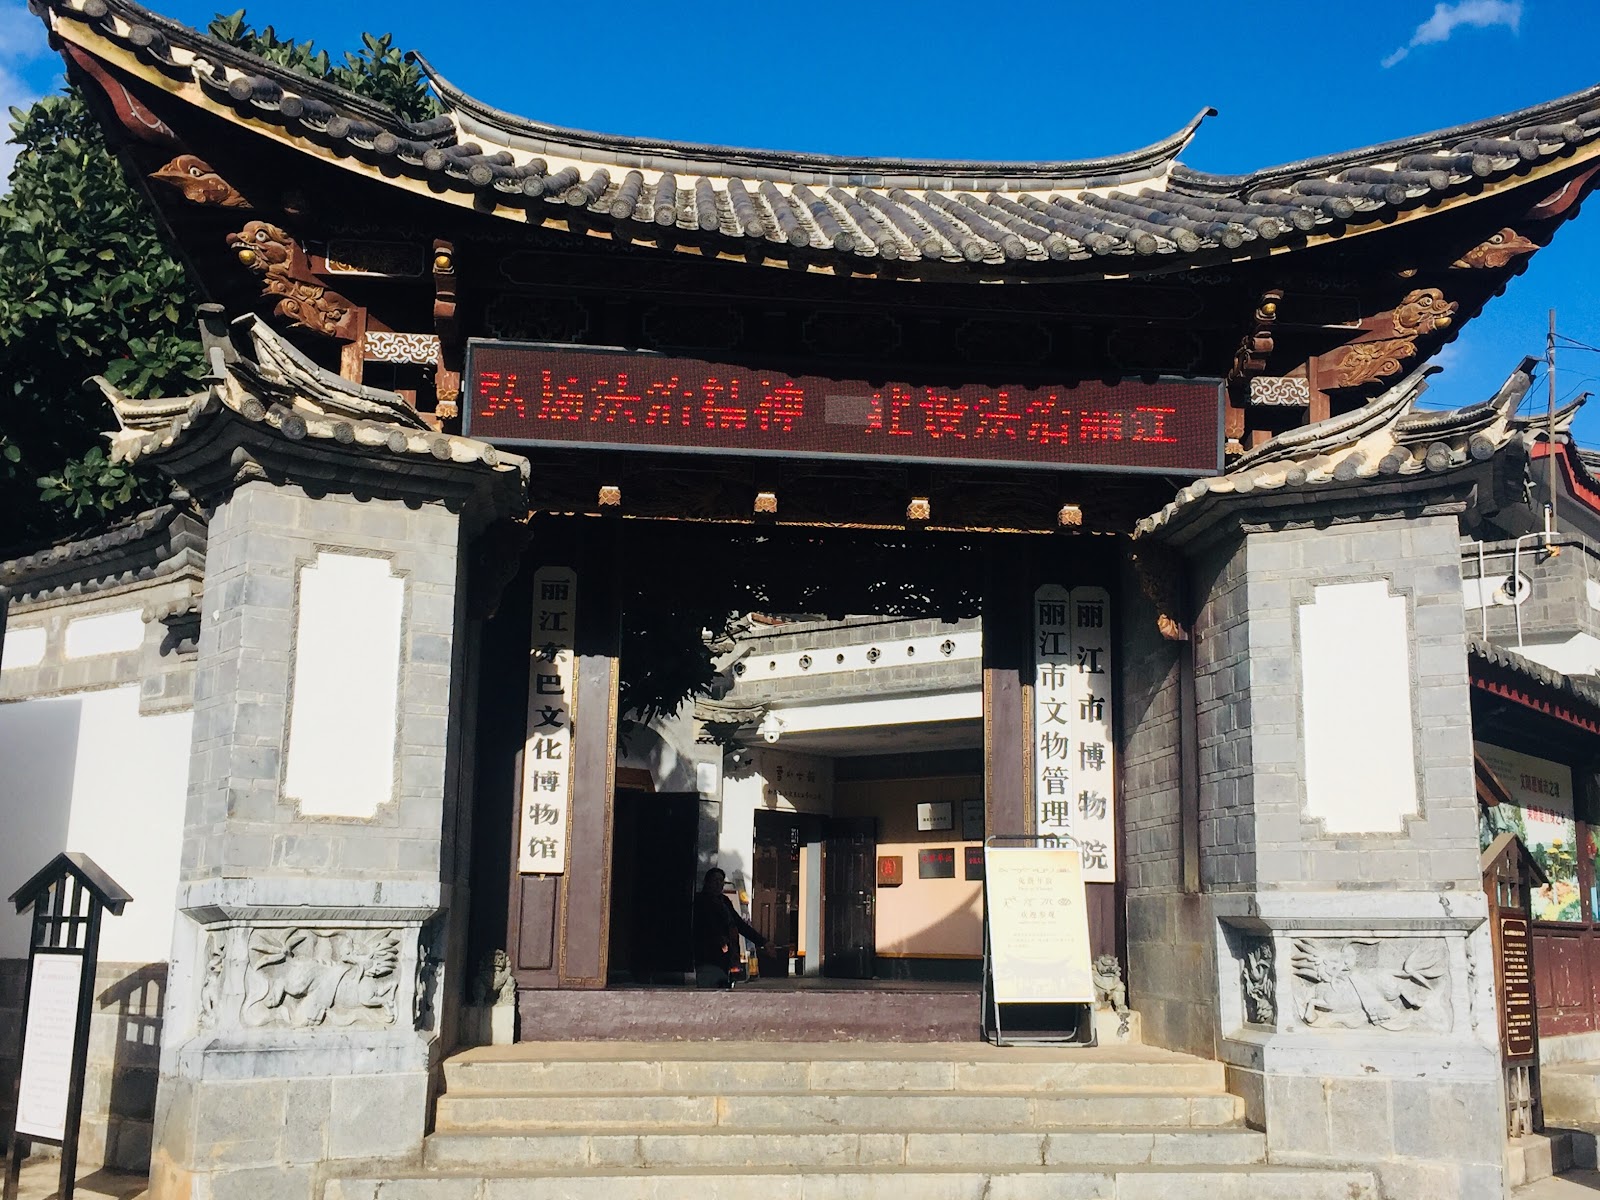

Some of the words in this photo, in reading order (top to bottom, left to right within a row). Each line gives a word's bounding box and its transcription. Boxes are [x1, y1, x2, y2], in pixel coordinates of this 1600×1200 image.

[527, 578, 571, 860] 丽江东巴文化博物馆
[1076, 598, 1109, 870] 丽江市博物院
